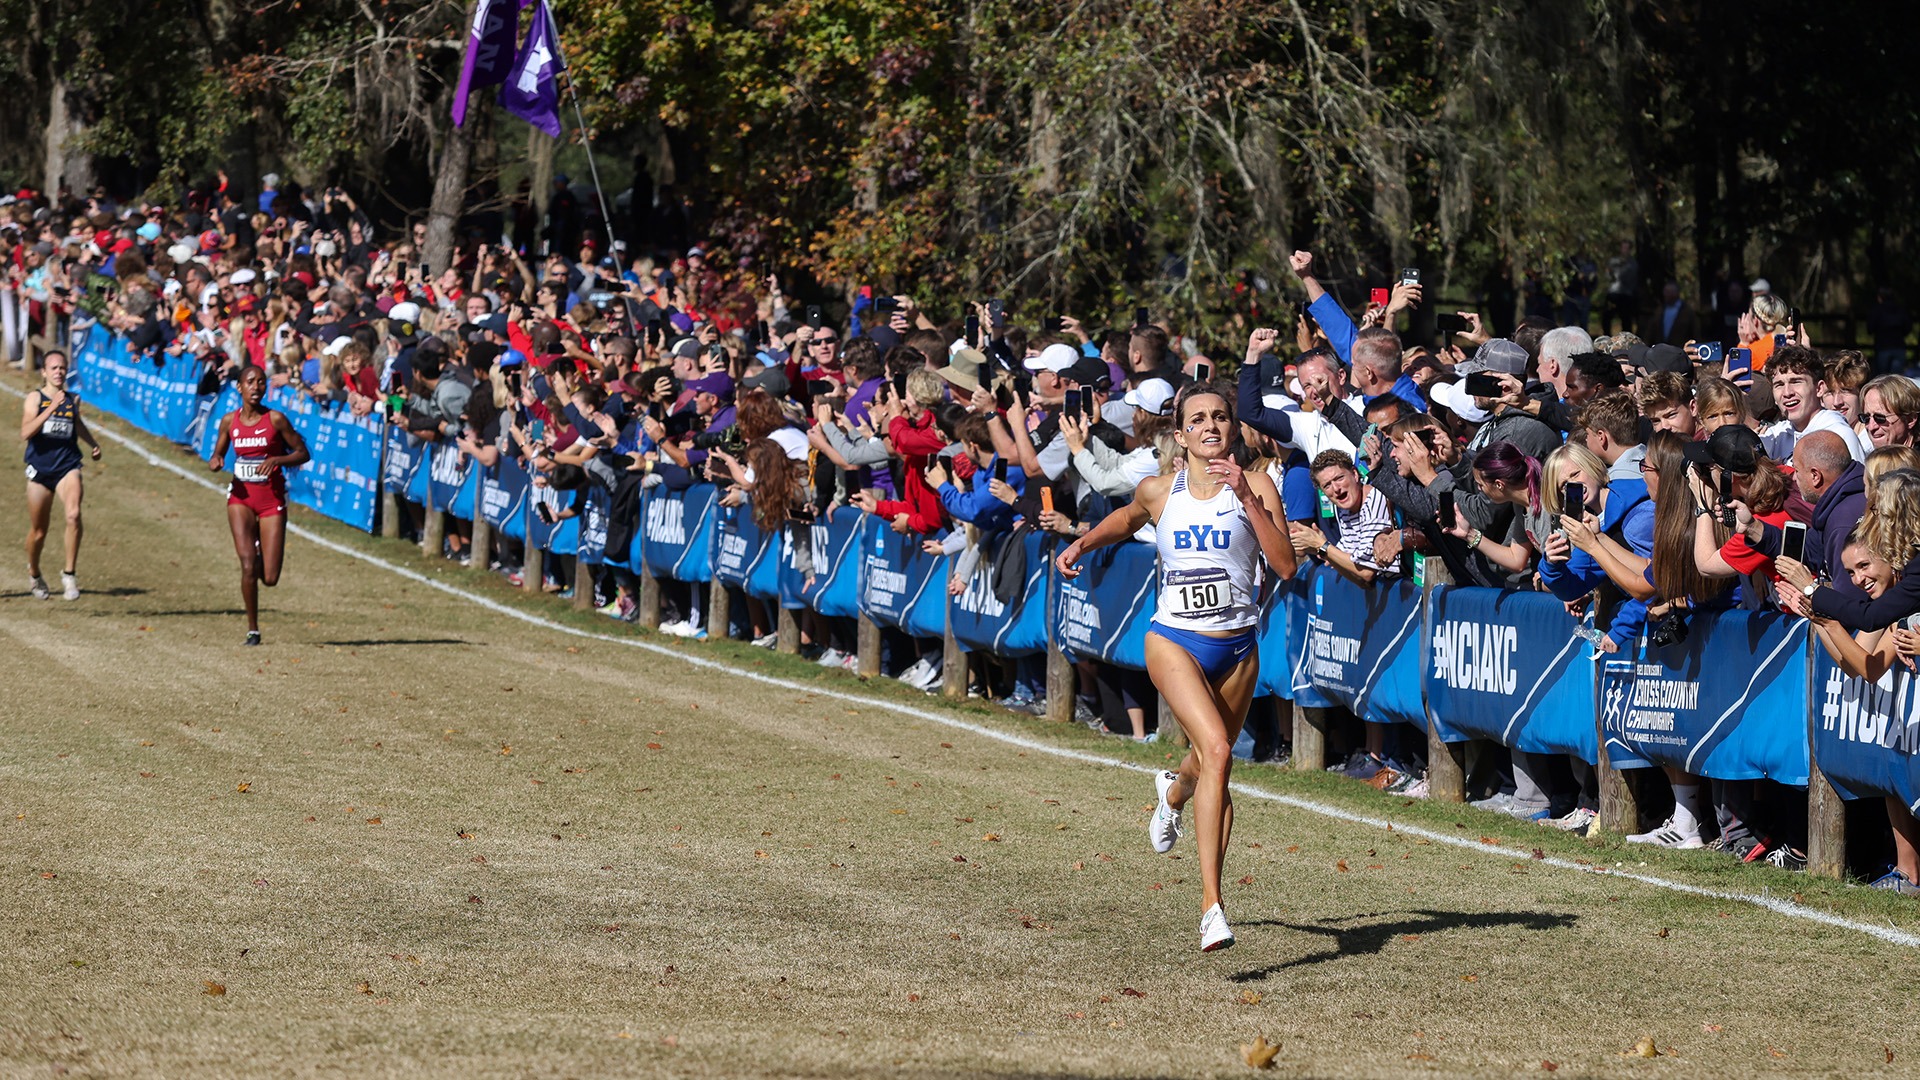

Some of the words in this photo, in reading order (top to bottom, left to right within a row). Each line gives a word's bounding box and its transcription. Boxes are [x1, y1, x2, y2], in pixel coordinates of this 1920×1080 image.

[234, 437, 268, 448] ALABAMA
[1173, 524, 1232, 552] BYU
[1179, 584, 1219, 610] 150
[1331, 635, 1361, 665] COUNTRY
[1433, 620, 1517, 696] #NCAAXC
[1633, 679, 1660, 708] CROSS
[1660, 681, 1699, 710] COUNTRY
[1626, 709, 1675, 732] CHAMPIONSHIPS
